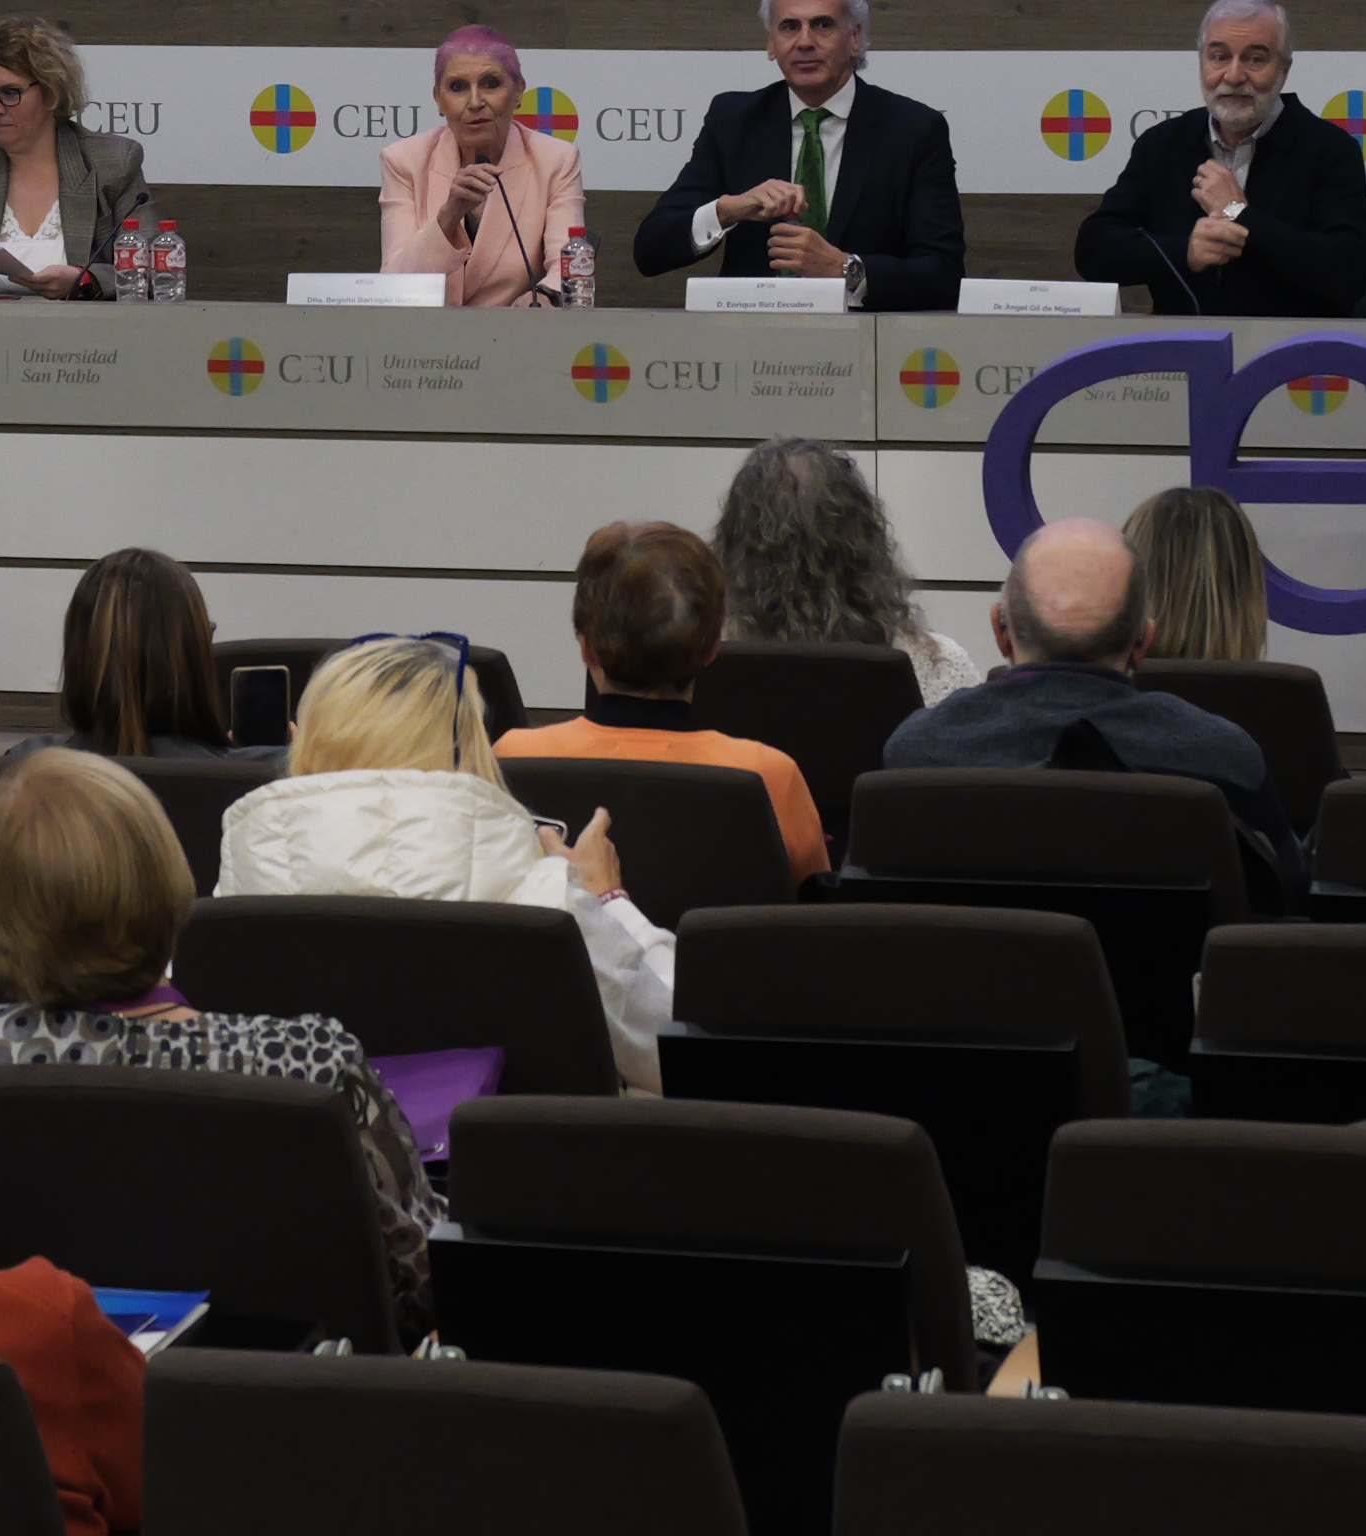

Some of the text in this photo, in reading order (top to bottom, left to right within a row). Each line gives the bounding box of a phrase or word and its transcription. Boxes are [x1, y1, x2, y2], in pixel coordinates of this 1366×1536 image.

[75, 101, 165, 136] CEU
[333, 104, 421, 139] CEU
[595, 107, 686, 143] CEU
[727, 301, 757, 310] Enrique
[22, 348, 118, 364] Universidad
[383, 354, 481, 371] Universidad
[55, 368, 101, 384] Pablo
[278, 354, 353, 385] CEU
[644, 360, 722, 392] CEU
[752, 360, 853, 377] Universidad
[417, 375, 463, 390] Pablo
[787, 381, 835, 397] Pablo
[1121, 385, 1171, 403] Pablo
